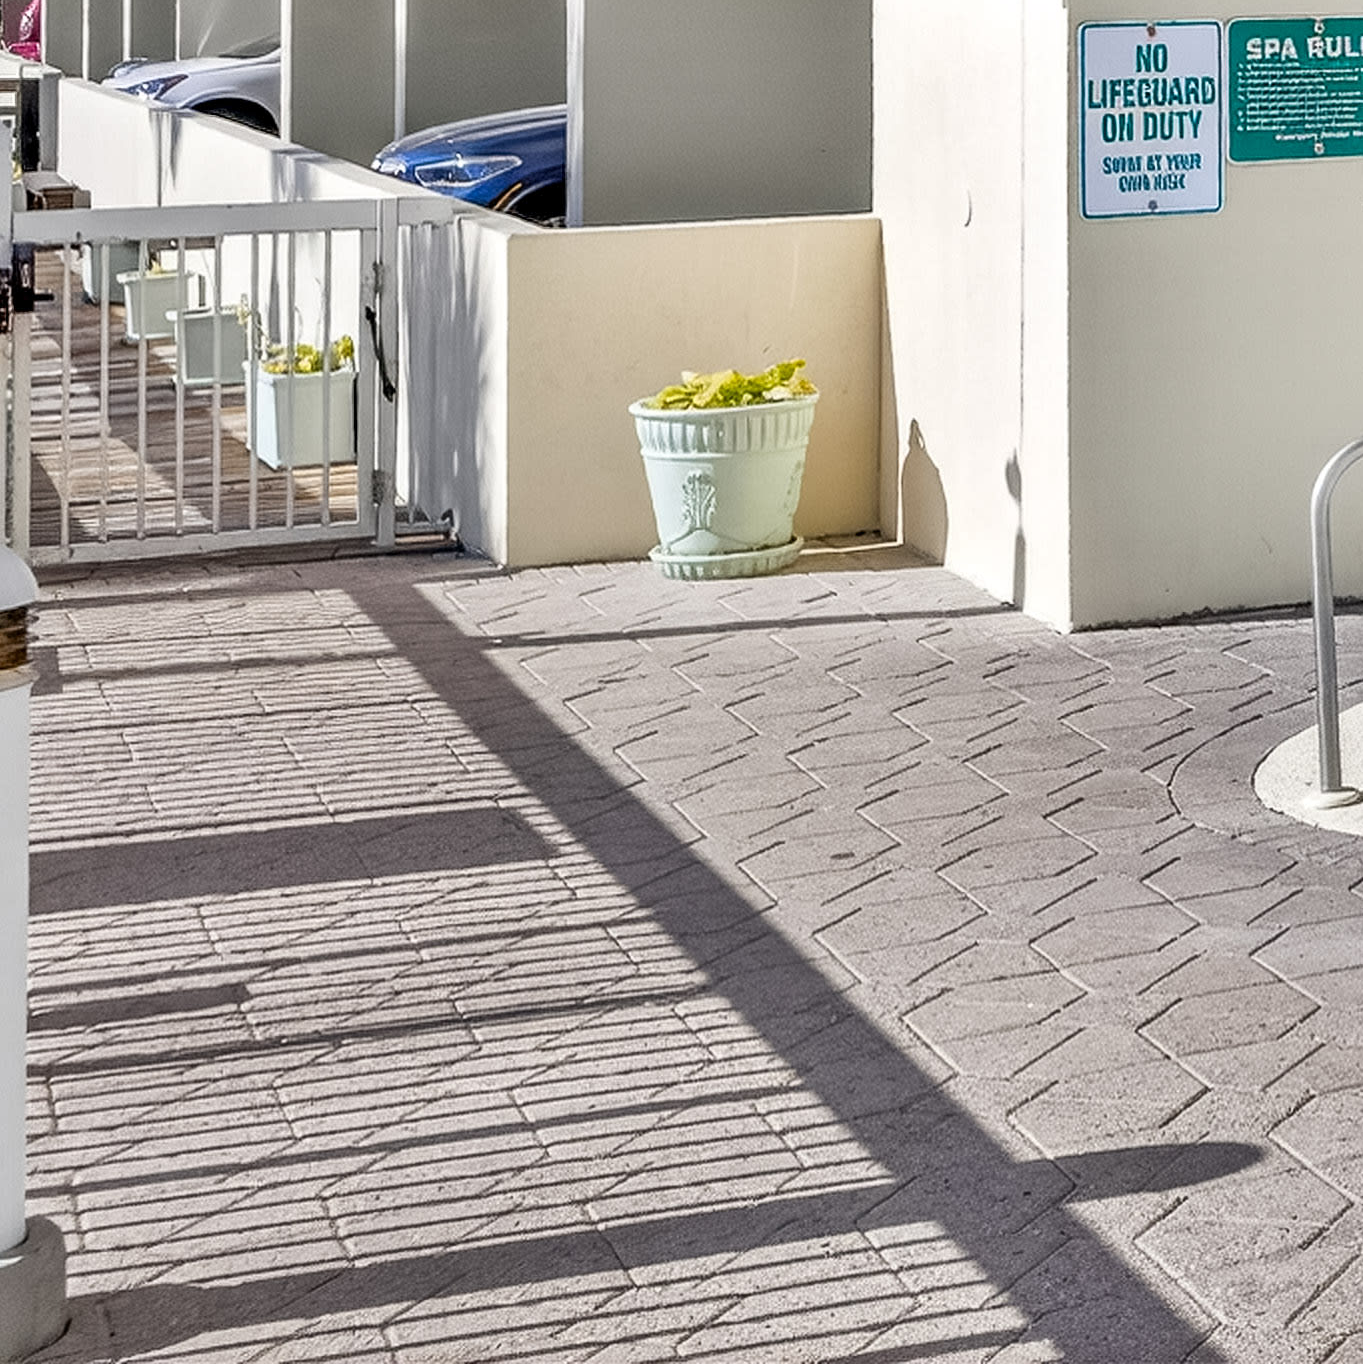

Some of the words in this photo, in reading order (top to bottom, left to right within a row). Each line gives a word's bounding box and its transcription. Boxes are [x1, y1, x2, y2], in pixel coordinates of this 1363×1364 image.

[1136, 44, 1167, 72] NO
[1246, 37, 1298, 61] SPA
[1088, 76, 1215, 109] LIFEGUARD
[1102, 112, 1133, 143] ON
[1143, 110, 1202, 141] DUTY
[1167, 153, 1202, 171] YOUR
